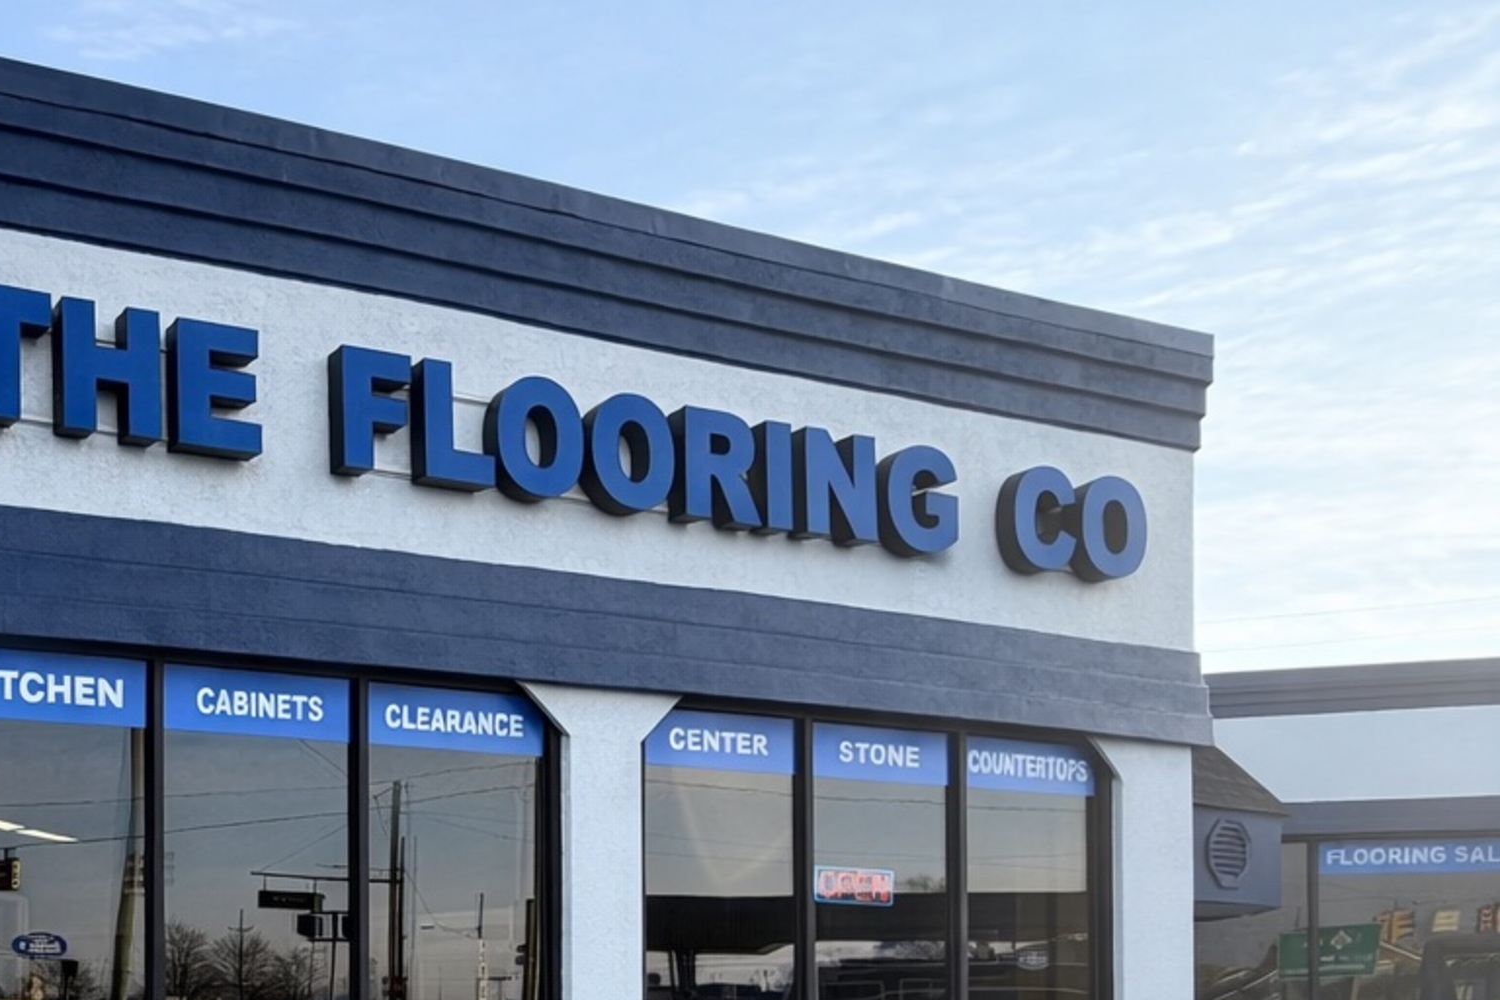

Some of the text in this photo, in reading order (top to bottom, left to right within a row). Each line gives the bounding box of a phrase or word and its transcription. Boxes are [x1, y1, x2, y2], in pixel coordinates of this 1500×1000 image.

[327, 344, 960, 557] FLOORING
[995, 465, 1148, 583] CO
[196, 686, 325, 723] CABINETS
[384, 704, 525, 738] CLEARANCE
[668, 727, 769, 757] CENTER
[838, 740, 921, 769] STONE
[967, 749, 1089, 782] COUNTERTOPS
[1326, 846, 1447, 866] FLOORING
